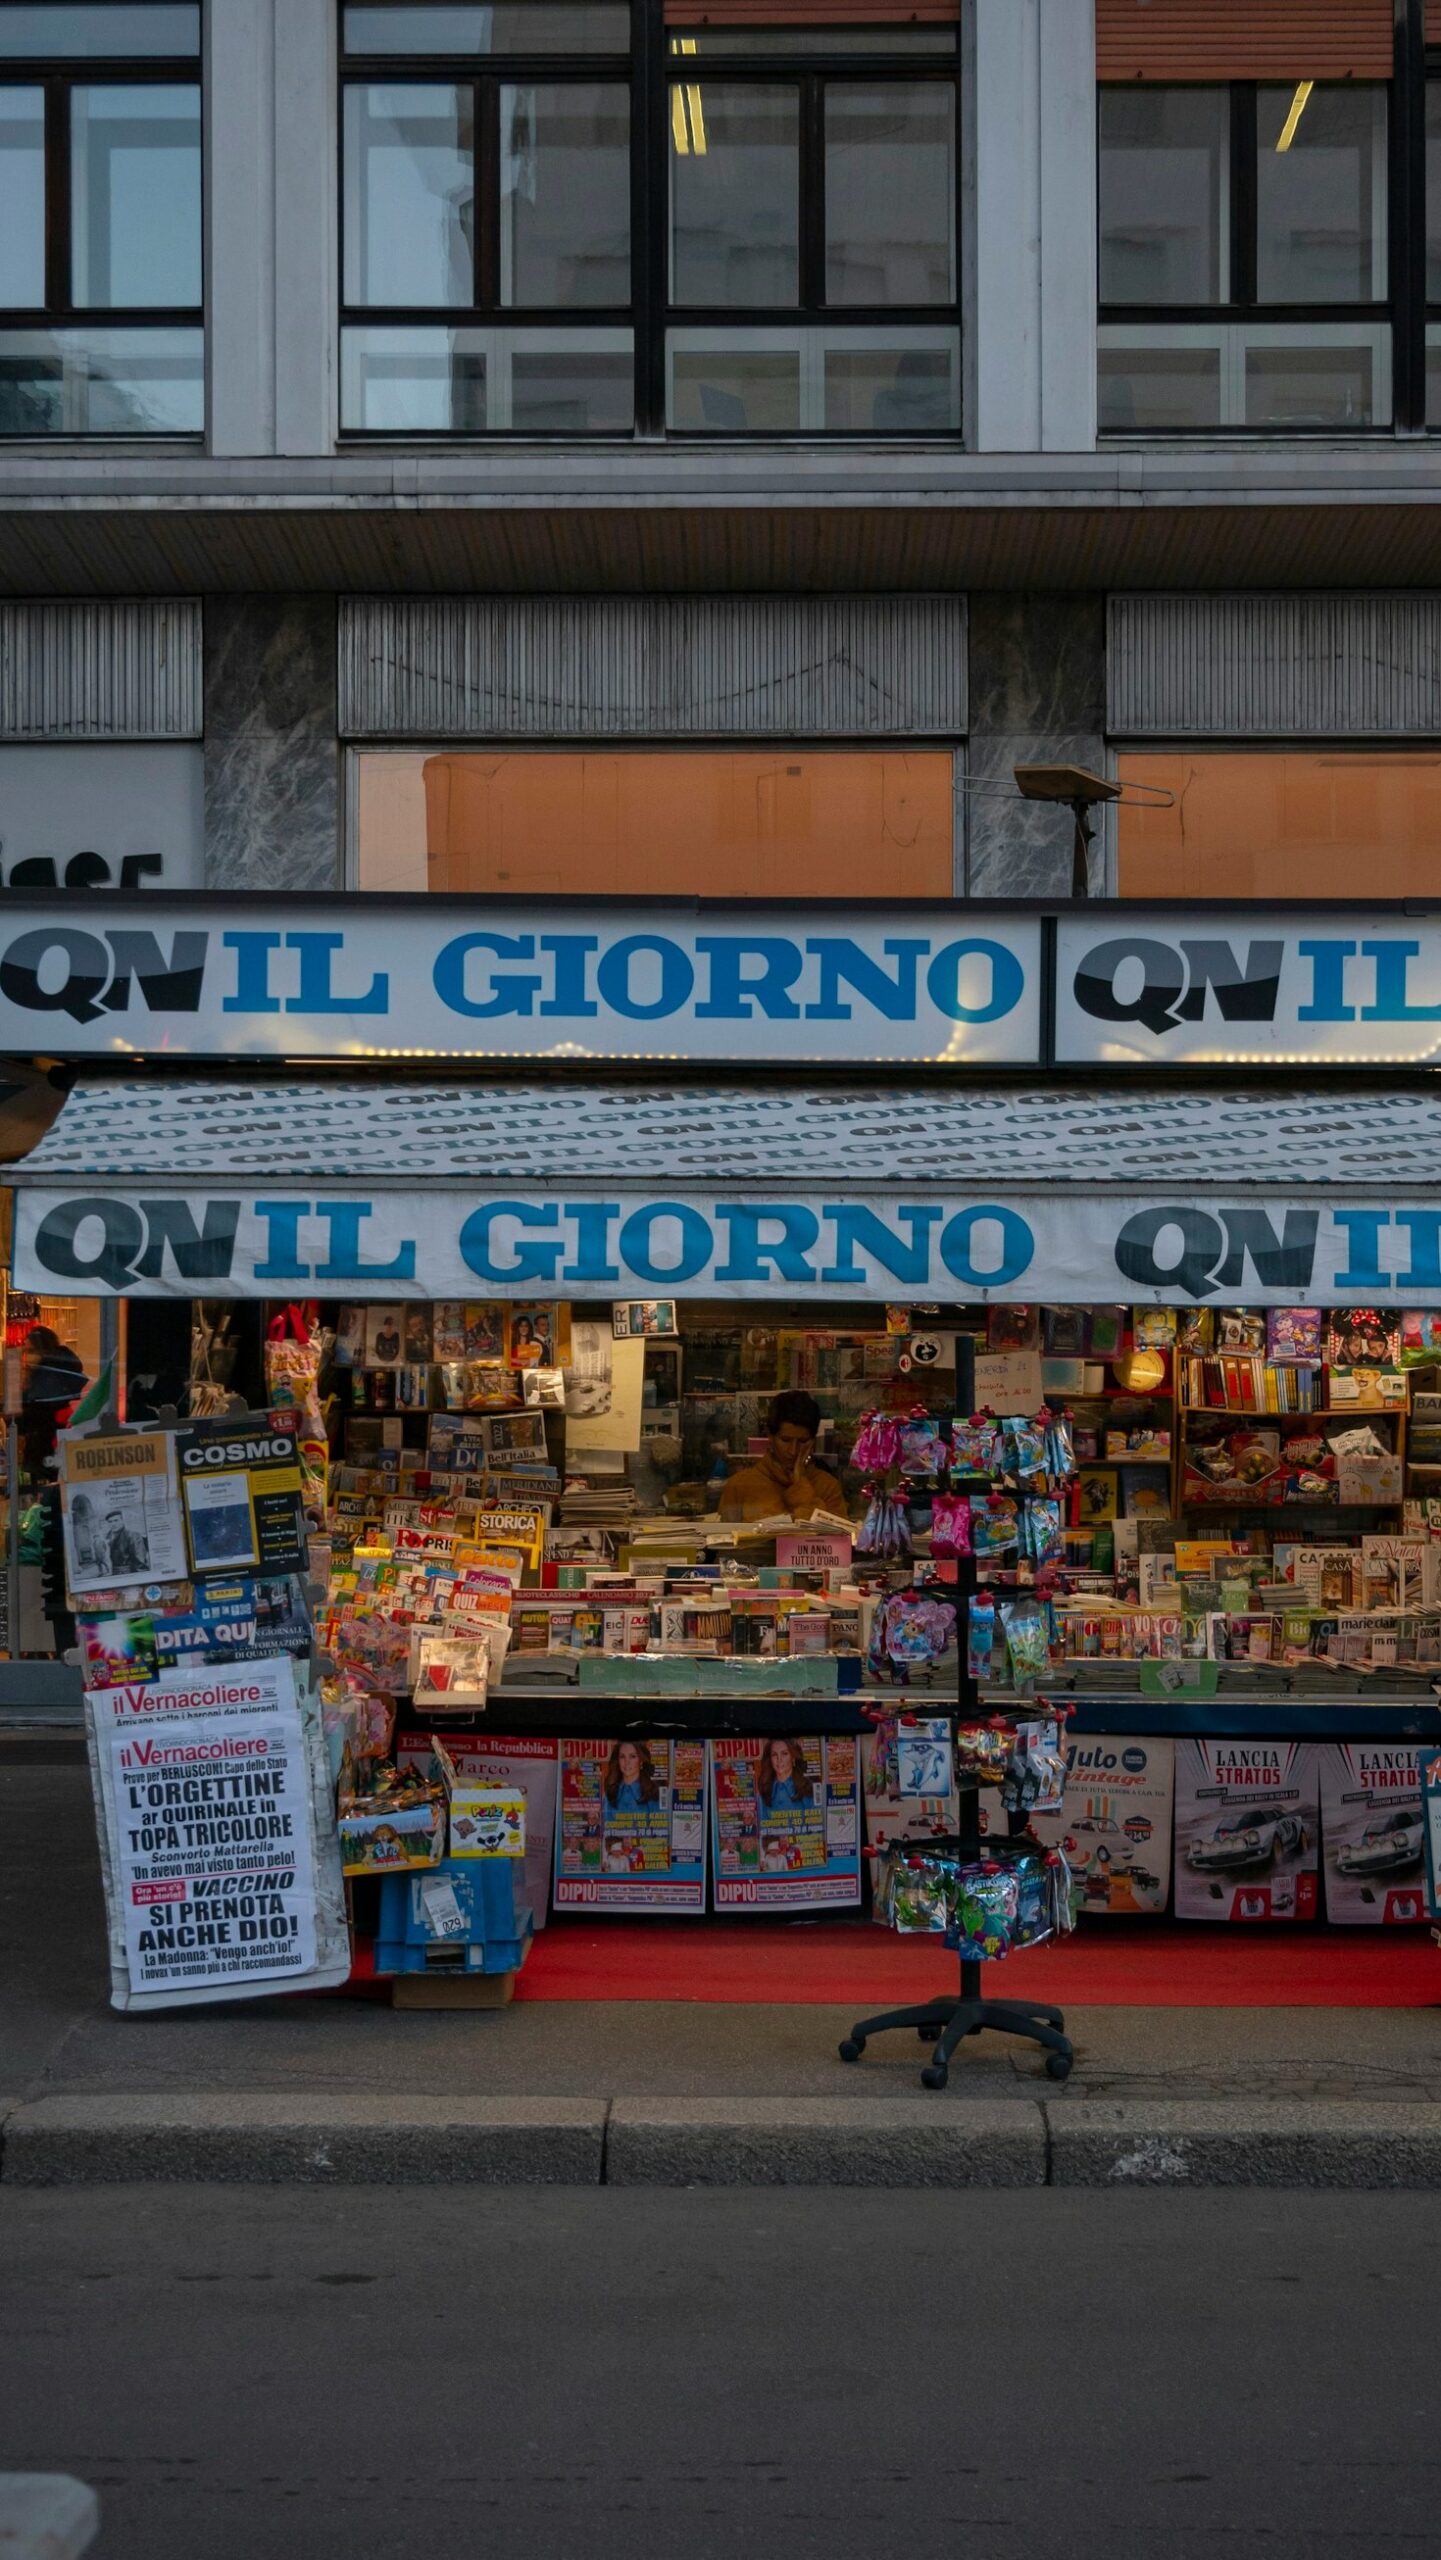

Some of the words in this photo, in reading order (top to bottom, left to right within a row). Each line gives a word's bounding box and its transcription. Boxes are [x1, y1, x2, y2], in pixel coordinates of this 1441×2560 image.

[0, 928, 209, 1024] QN
[223, 932, 389, 1014] IL
[433, 932, 1025, 1025] GIORNO
[1073, 938, 1285, 1035] QN
[148, 1100, 371, 1122] GIORNO
[367, 1100, 586, 1122] GIORNO
[172, 1129, 402, 1152] GIORNO
[578, 1100, 793, 1123] GIORNO
[399, 1129, 624, 1152] GIORNO
[795, 1100, 1006, 1124] GIORNO
[617, 1131, 837, 1152] GIORNO
[1004, 1099, 1212, 1124] GIORNO
[840, 1131, 1057, 1153] GIORNO
[1220, 1098, 1423, 1122] GIORNO
[1056, 1129, 1268, 1153] GIORNO
[35, 1198, 241, 1290] QN
[254, 1201, 416, 1280] IL
[459, 1201, 1034, 1287] GIORNO
[1115, 1206, 1320, 1299] QN
[75, 1444, 156, 1470] ROBINSON
[183, 1438, 293, 1466] COSMO
[488, 1451, 535, 1464] Bell'Italia
[480, 1514, 536, 1531] STORICA
[790, 1555, 816, 1567] TUTTO
[816, 1555, 840, 1567] D'ORO
[797, 1545, 810, 1556] UN
[810, 1544, 833, 1556] ANNO
[453, 1593, 478, 1610] QUIZ
[1341, 1617, 1373, 1630] marie
[113, 1696, 124, 1714] il
[125, 1685, 260, 1713] Vernacoliere
[120, 1749, 132, 1767] il
[132, 1738, 268, 1766] Vernacoliere
[476, 1740, 488, 1751] la
[490, 1742, 554, 1755] Repubblica
[1216, 1749, 1280, 1767] LANCIA
[123, 1772, 146, 1785] Prove
[162, 1762, 223, 1780] BERLUSCONI
[225, 1762, 244, 1775] Capo
[246, 1759, 265, 1771] dello
[267, 1757, 288, 1770] Stato
[1216, 1767, 1280, 1785] STRATOS
[129, 1771, 286, 1809] L'ORGETTINE
[142, 1811, 158, 1826] ar
[162, 1799, 257, 1824] QUIRINALE
[260, 1798, 276, 1813] in
[128, 1826, 180, 1853] TOPA
[183, 1813, 293, 1847] TRICOLORE
[151, 1847, 210, 1863] Sconvorto
[213, 1841, 274, 1857] Mattarella
[151, 1863, 182, 1878] avevo
[184, 1859, 205, 1875] mai
[207, 1856, 234, 1873] visto
[236, 1853, 265, 1870] tanto
[267, 1850, 295, 1869] pelo!
[193, 1871, 295, 1898] VACCINO
[558, 1879, 598, 1903] DIPIÙ
[717, 1878, 757, 1902] DIPIÙ
[149, 1904, 173, 1927] SI
[180, 1893, 285, 1924] PRENOTA
[138, 1922, 231, 1951] ANCHE
[239, 1914, 299, 1942] DIO!
[144, 1954, 156, 1967] La
[158, 1950, 209, 1965] Madonna:
[145, 1967, 168, 1979] novax
[182, 1964, 207, 1976] sanno
[241, 1953, 302, 1970] raccomandassi
